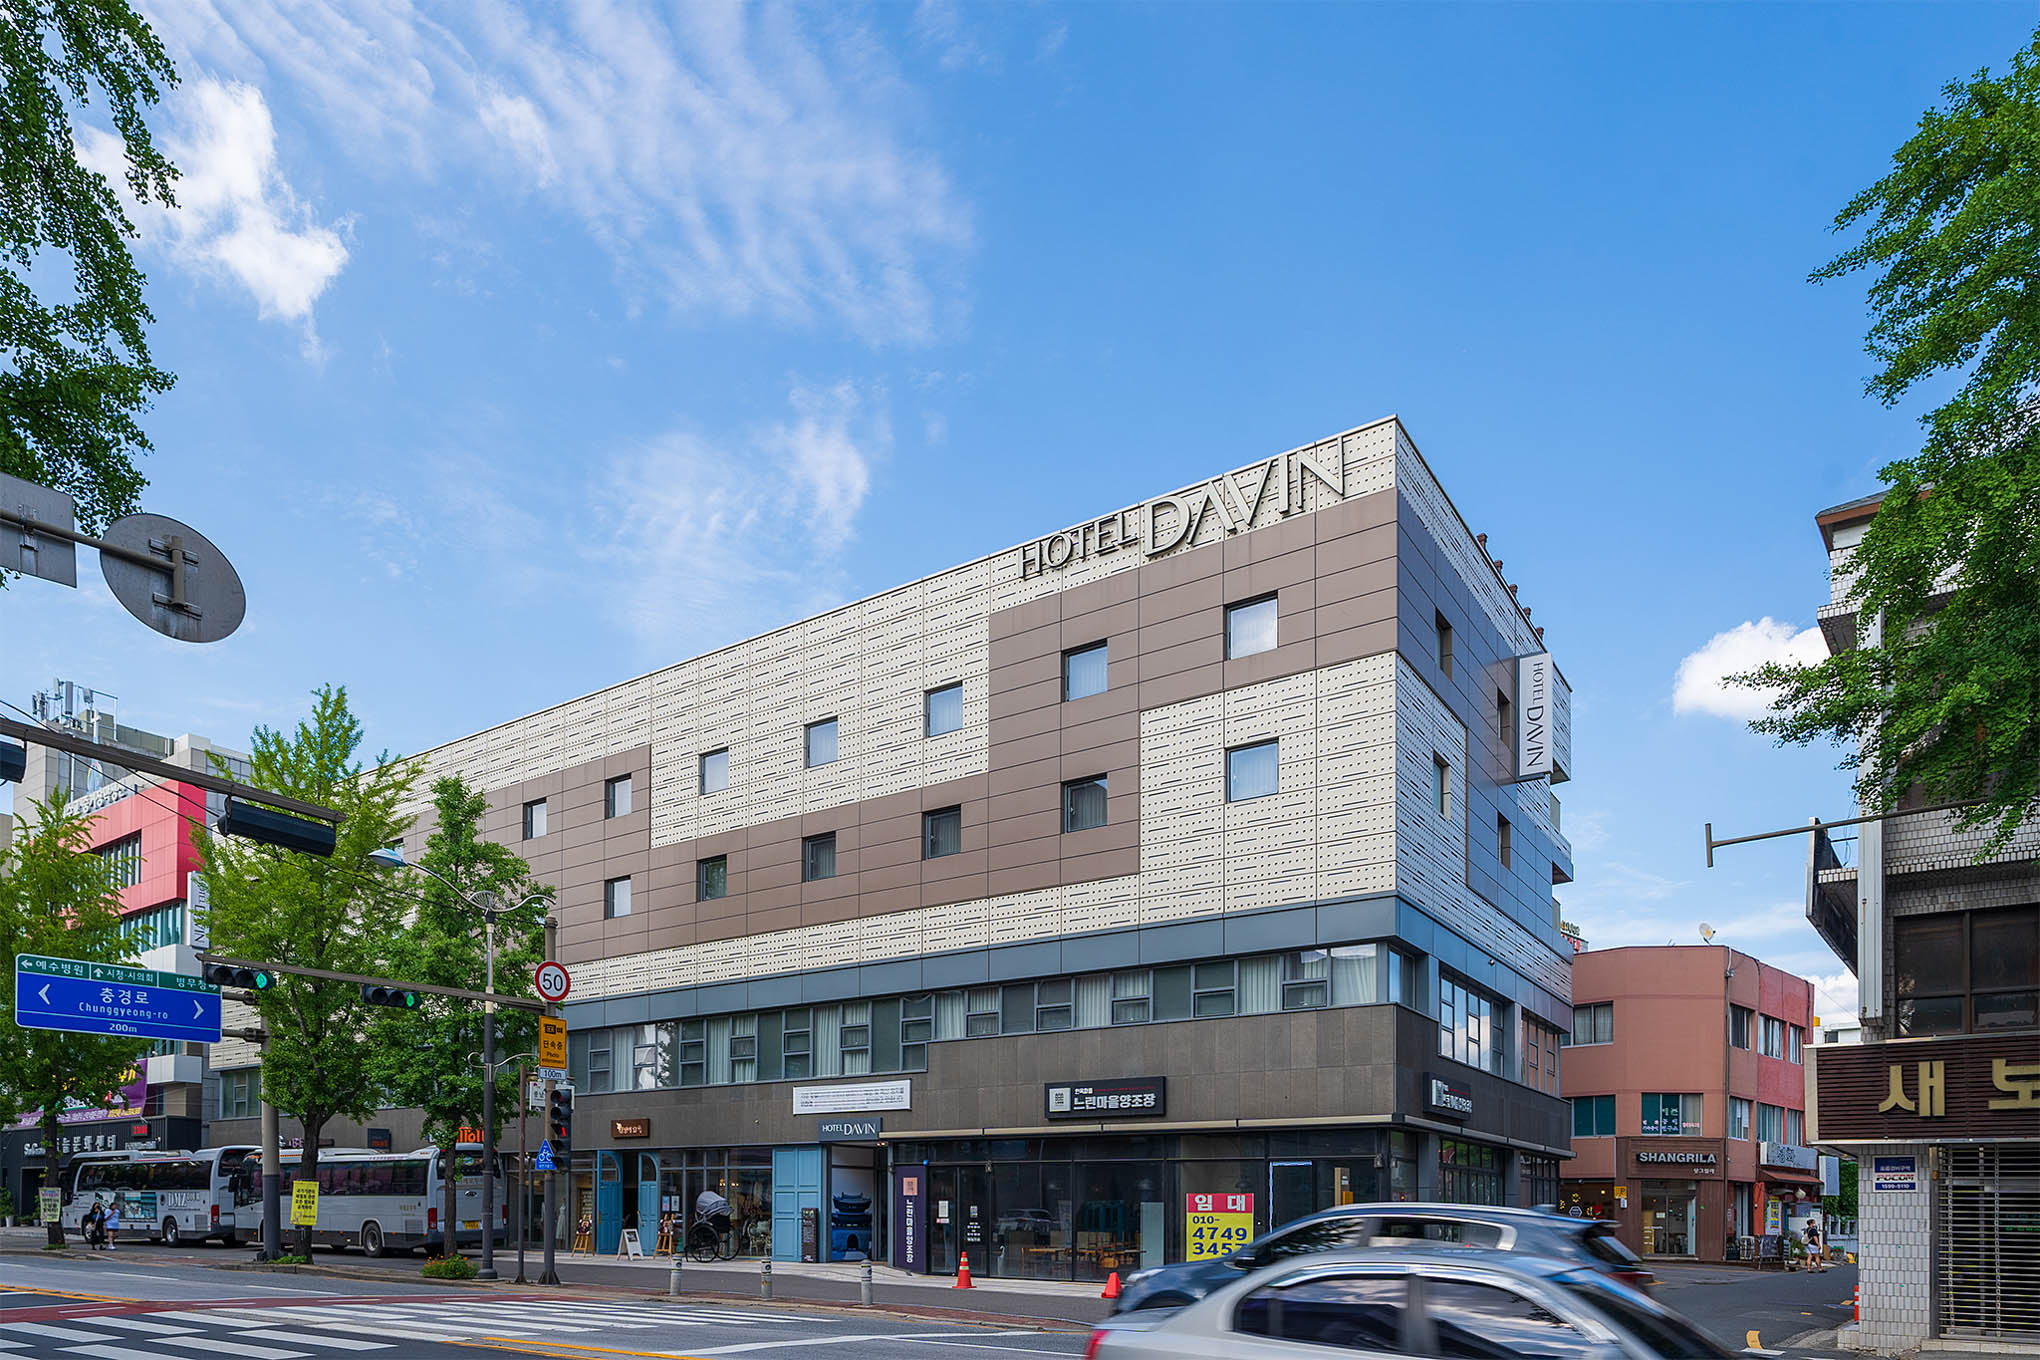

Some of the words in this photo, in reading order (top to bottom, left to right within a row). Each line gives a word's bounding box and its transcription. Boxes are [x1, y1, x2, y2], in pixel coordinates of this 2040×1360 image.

[1018, 512, 1138, 579] HOTEL
[1143, 436, 1346, 558] DAVIN
[1533, 662, 1544, 704] HOTEL
[1527, 705, 1544, 767] DAVIN
[35, 960, 84, 976] 예수병원
[542, 973, 564, 992] 50
[100, 988, 150, 1005] 충경로
[79, 1002, 169, 1020] Chunggyeong-ro
[109, 1023, 137, 1033] 200m
[543, 1040, 563, 1050] 단속중
[543, 1070, 562, 1078] 100m
[1073, 1092, 1157, 1110] 느린마을양조장
[822, 1124, 843, 1133] HOTEL
[844, 1122, 877, 1136] DAVIN
[1640, 1152, 1717, 1164] SHANGRILA
[167, 1192, 187, 1208] DMZ
[1192, 1216, 1221, 1224] 010-
[1192, 1227, 1248, 1241] 4749
